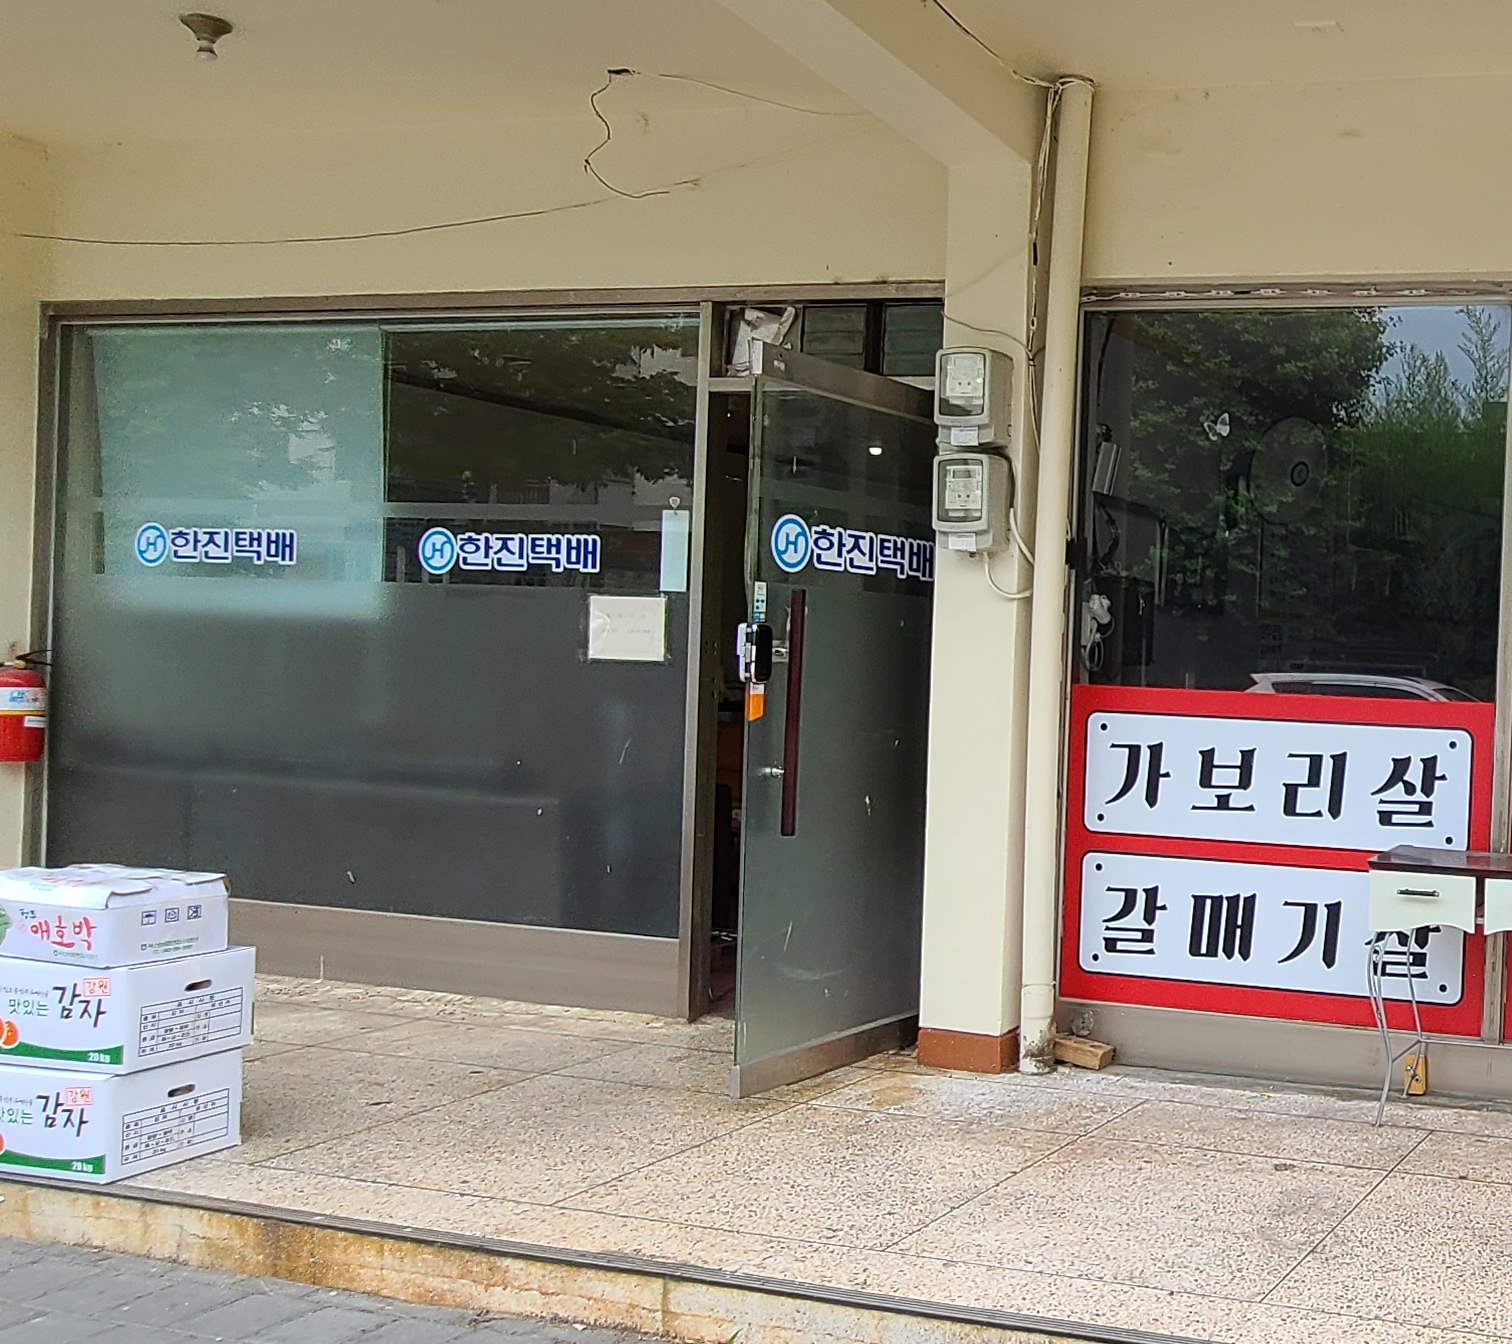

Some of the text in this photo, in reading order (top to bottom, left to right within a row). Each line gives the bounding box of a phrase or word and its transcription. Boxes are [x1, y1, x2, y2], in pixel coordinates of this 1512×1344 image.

[169, 528, 297, 565] 한진택배
[456, 532, 601, 573] 한진택배
[811, 525, 935, 581] 한진택배
[1106, 740, 1449, 830] 가보리살
[29, 914, 98, 951] 애호박
[1100, 885, 1442, 980] 갈매기살
[8, 998, 50, 1017] 맛있는
[52, 982, 108, 1029] 감자
[35, 1091, 89, 1138] 감자
